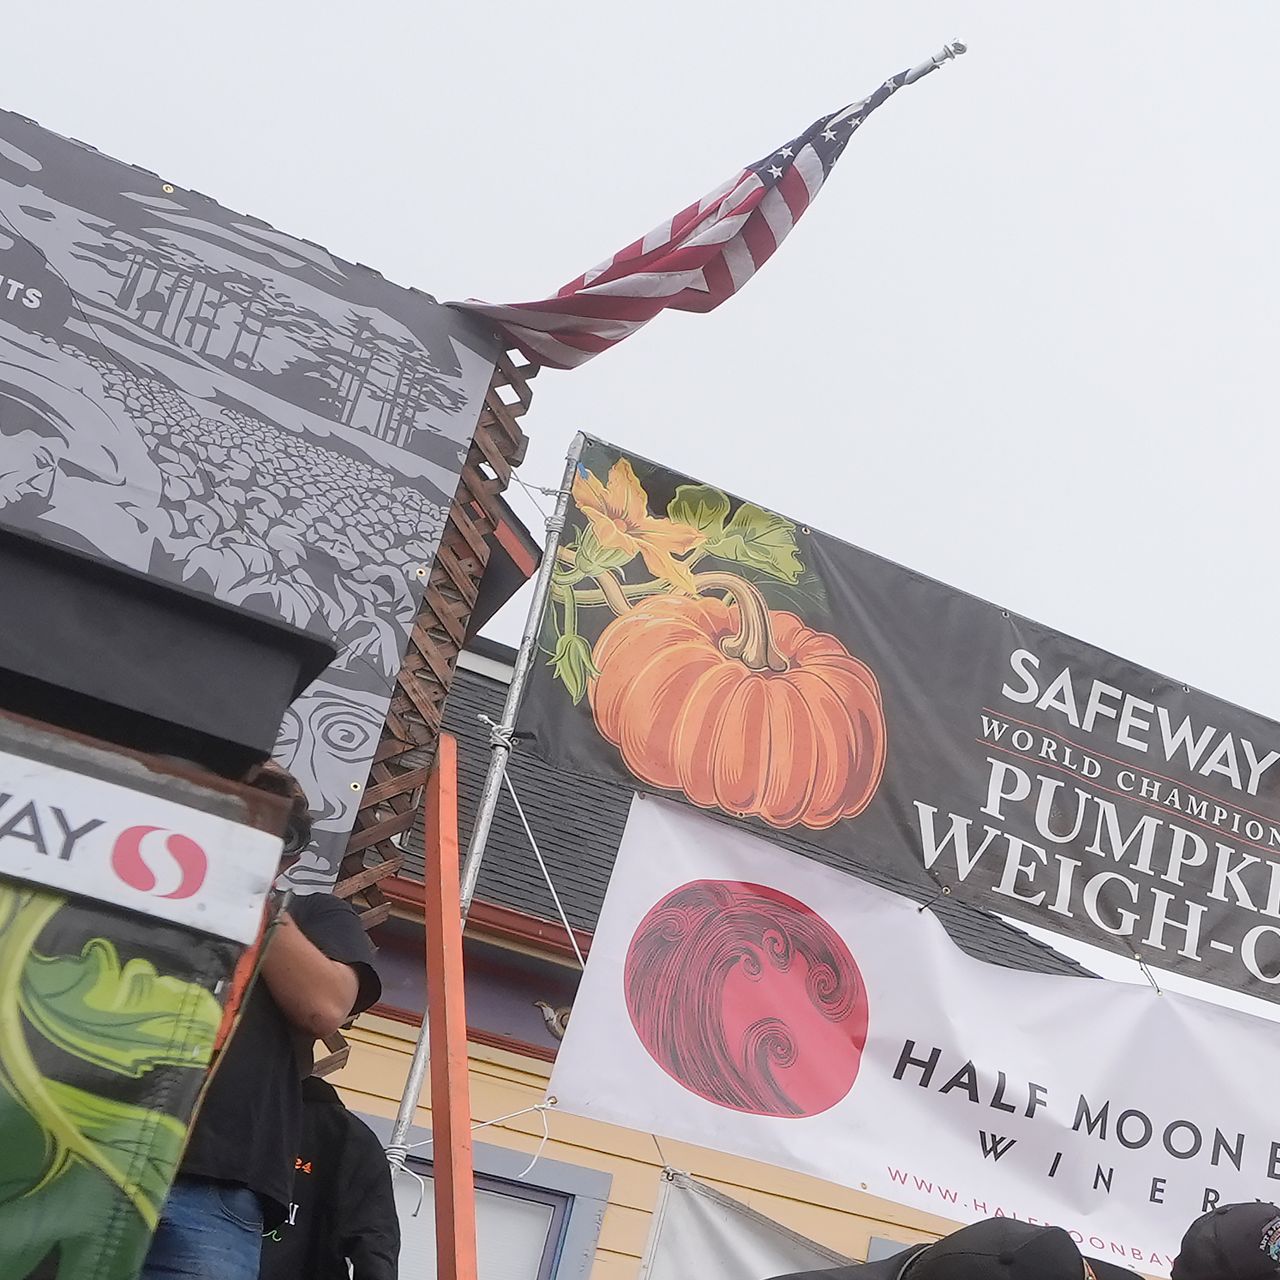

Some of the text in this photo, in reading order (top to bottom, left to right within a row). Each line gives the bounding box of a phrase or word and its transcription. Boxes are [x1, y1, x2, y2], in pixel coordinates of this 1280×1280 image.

[0, 274, 43, 309] TS
[980, 714, 1101, 780] WORLD
[0, 792, 107, 861] AY
[892, 1039, 1048, 1119] HALF
[1071, 1093, 1246, 1172] MOON
[978, 1129, 1275, 1212] WINER
